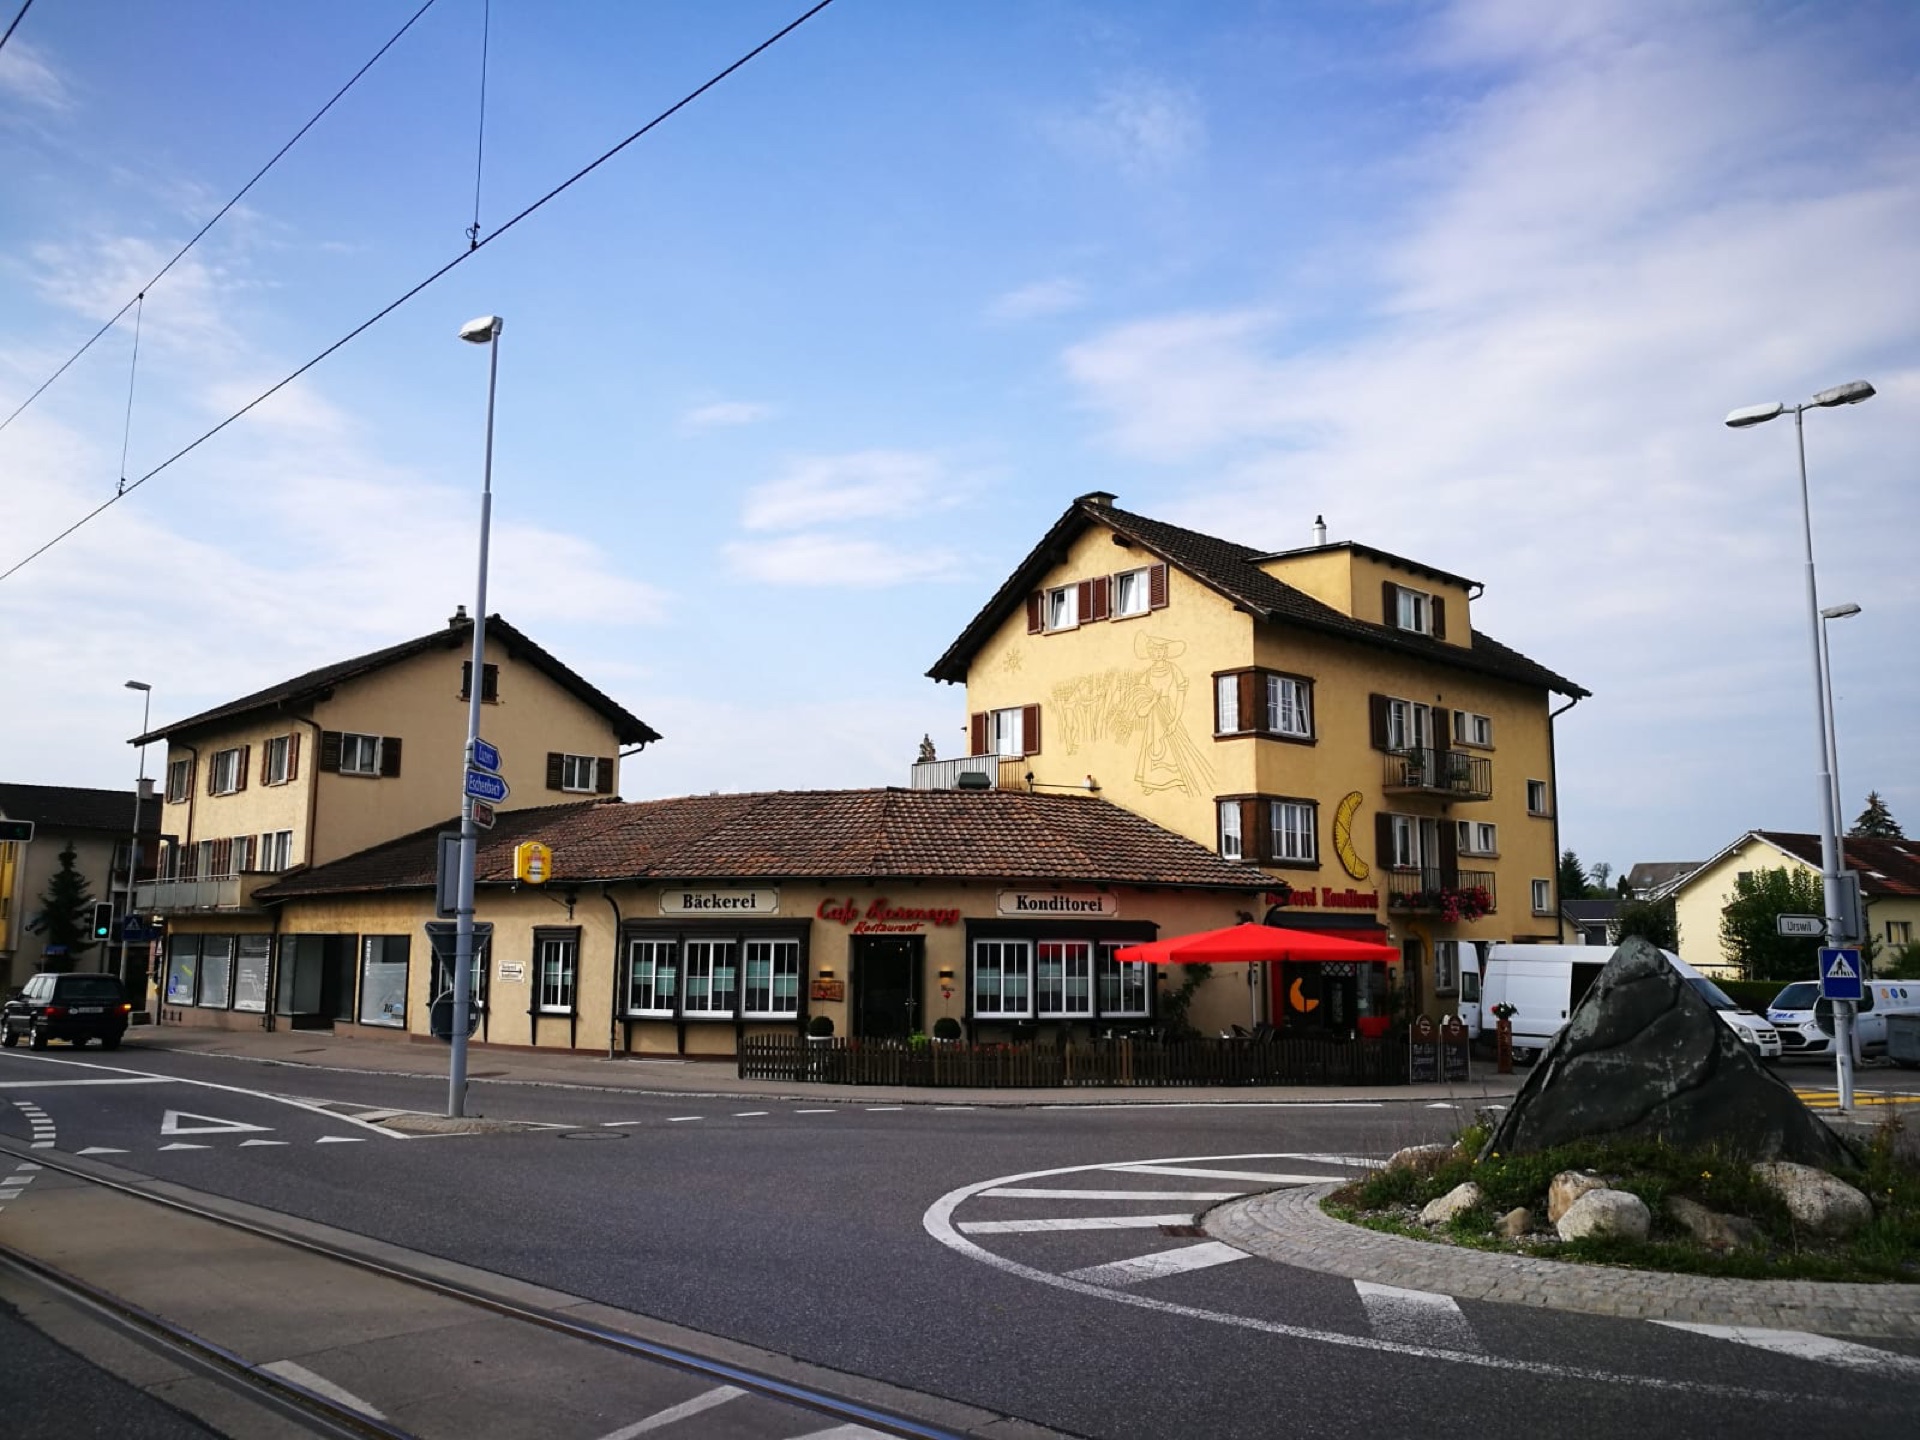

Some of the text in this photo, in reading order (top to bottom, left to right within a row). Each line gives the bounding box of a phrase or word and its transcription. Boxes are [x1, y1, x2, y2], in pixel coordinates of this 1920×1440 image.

[468, 774, 500, 797] Eschenbach
[682, 893, 756, 909] Bäckerei
[1016, 894, 1103, 912] Konditorei
[853, 921, 925, 934] Restaurant
[1787, 921, 1812, 932] Urswil
